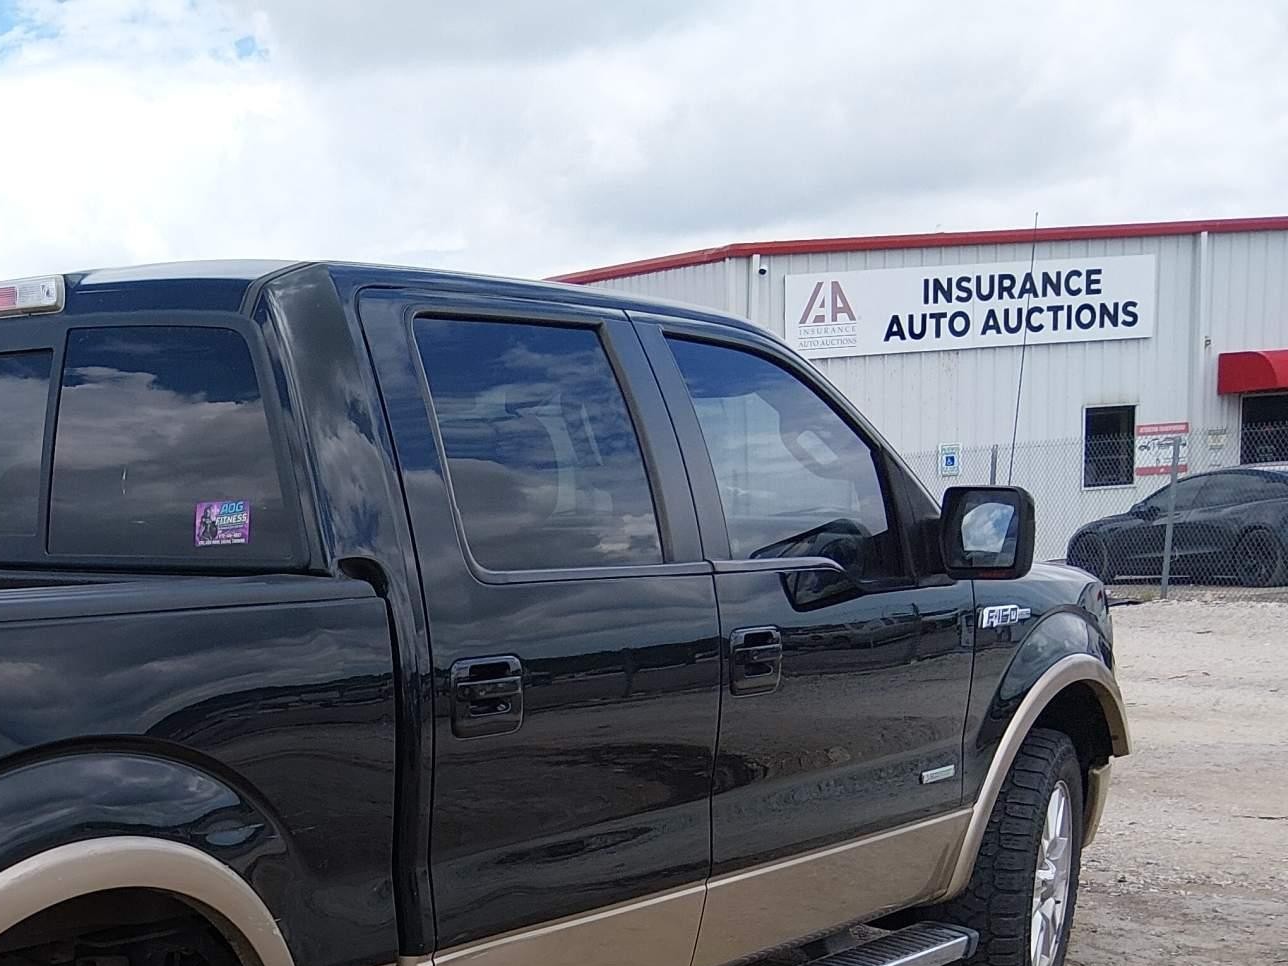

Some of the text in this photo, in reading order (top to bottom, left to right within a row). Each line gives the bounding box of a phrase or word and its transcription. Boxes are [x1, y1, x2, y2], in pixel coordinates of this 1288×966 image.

[923, 268, 1103, 305] INSURANCE
[799, 325, 857, 336] INSURANCE
[883, 301, 1139, 342] AUTO AUCTIONS
[798, 337, 857, 348] AUTO AUCTIONS
